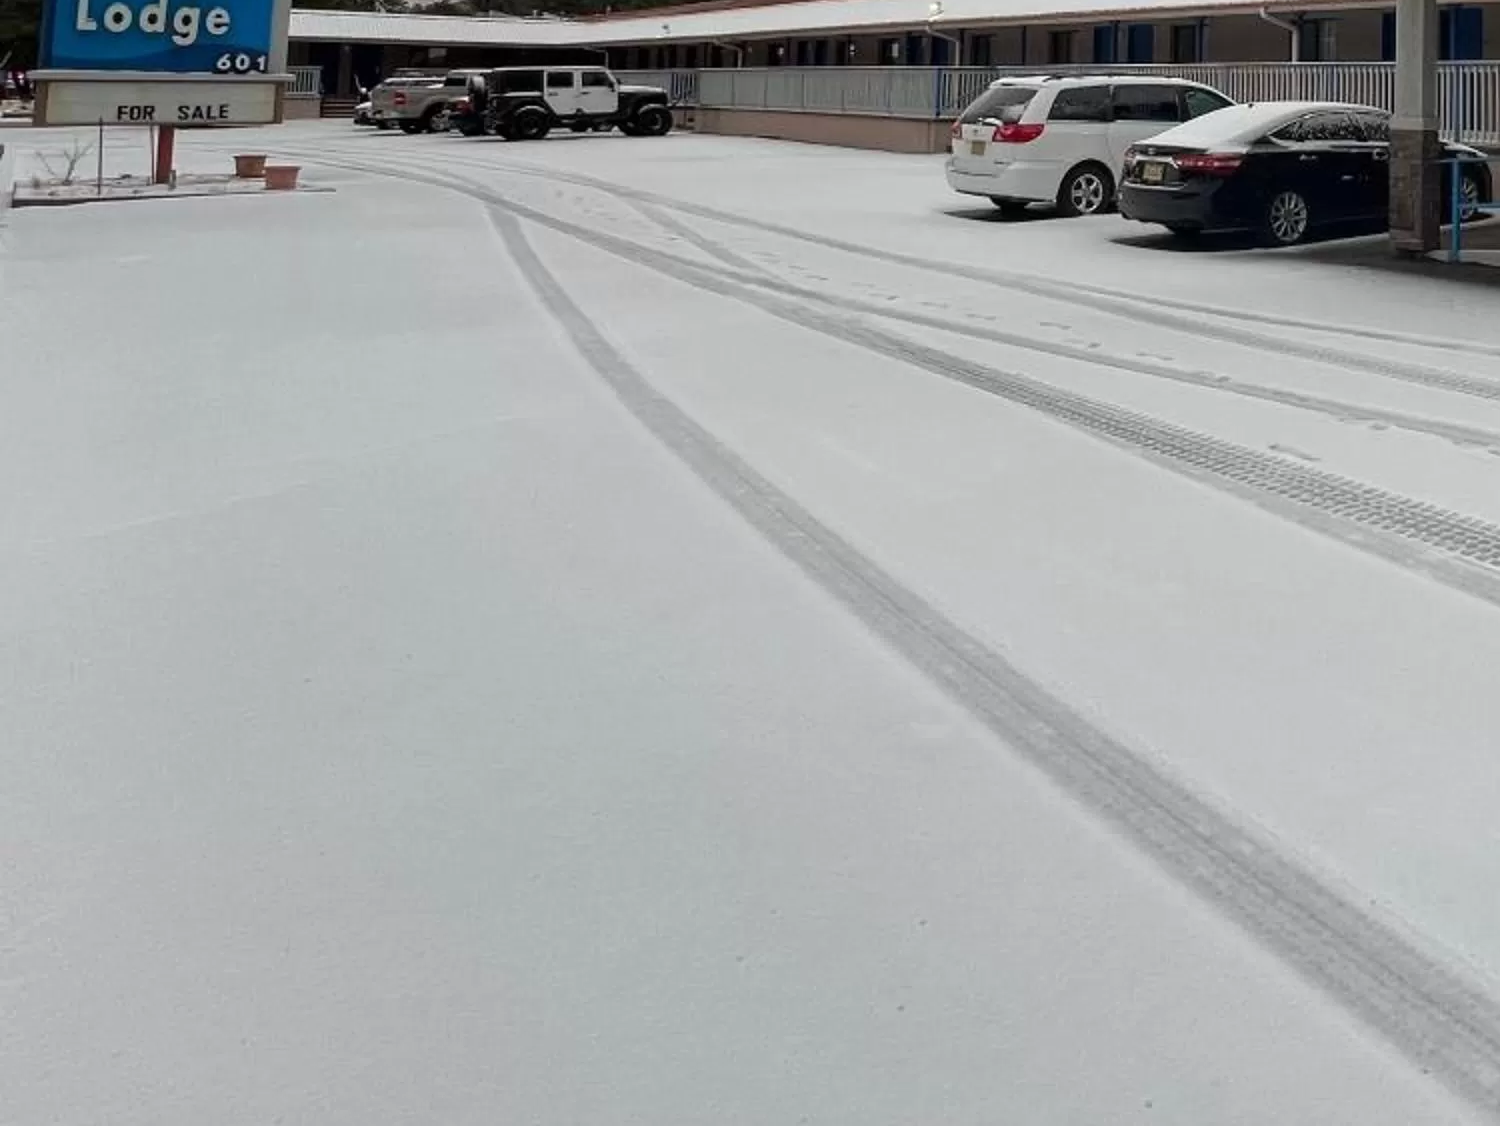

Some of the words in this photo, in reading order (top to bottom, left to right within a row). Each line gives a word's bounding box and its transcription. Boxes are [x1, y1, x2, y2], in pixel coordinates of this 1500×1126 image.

[215, 53, 267, 72] 601
[116, 104, 156, 121] FOR
[177, 103, 229, 120] SALE
